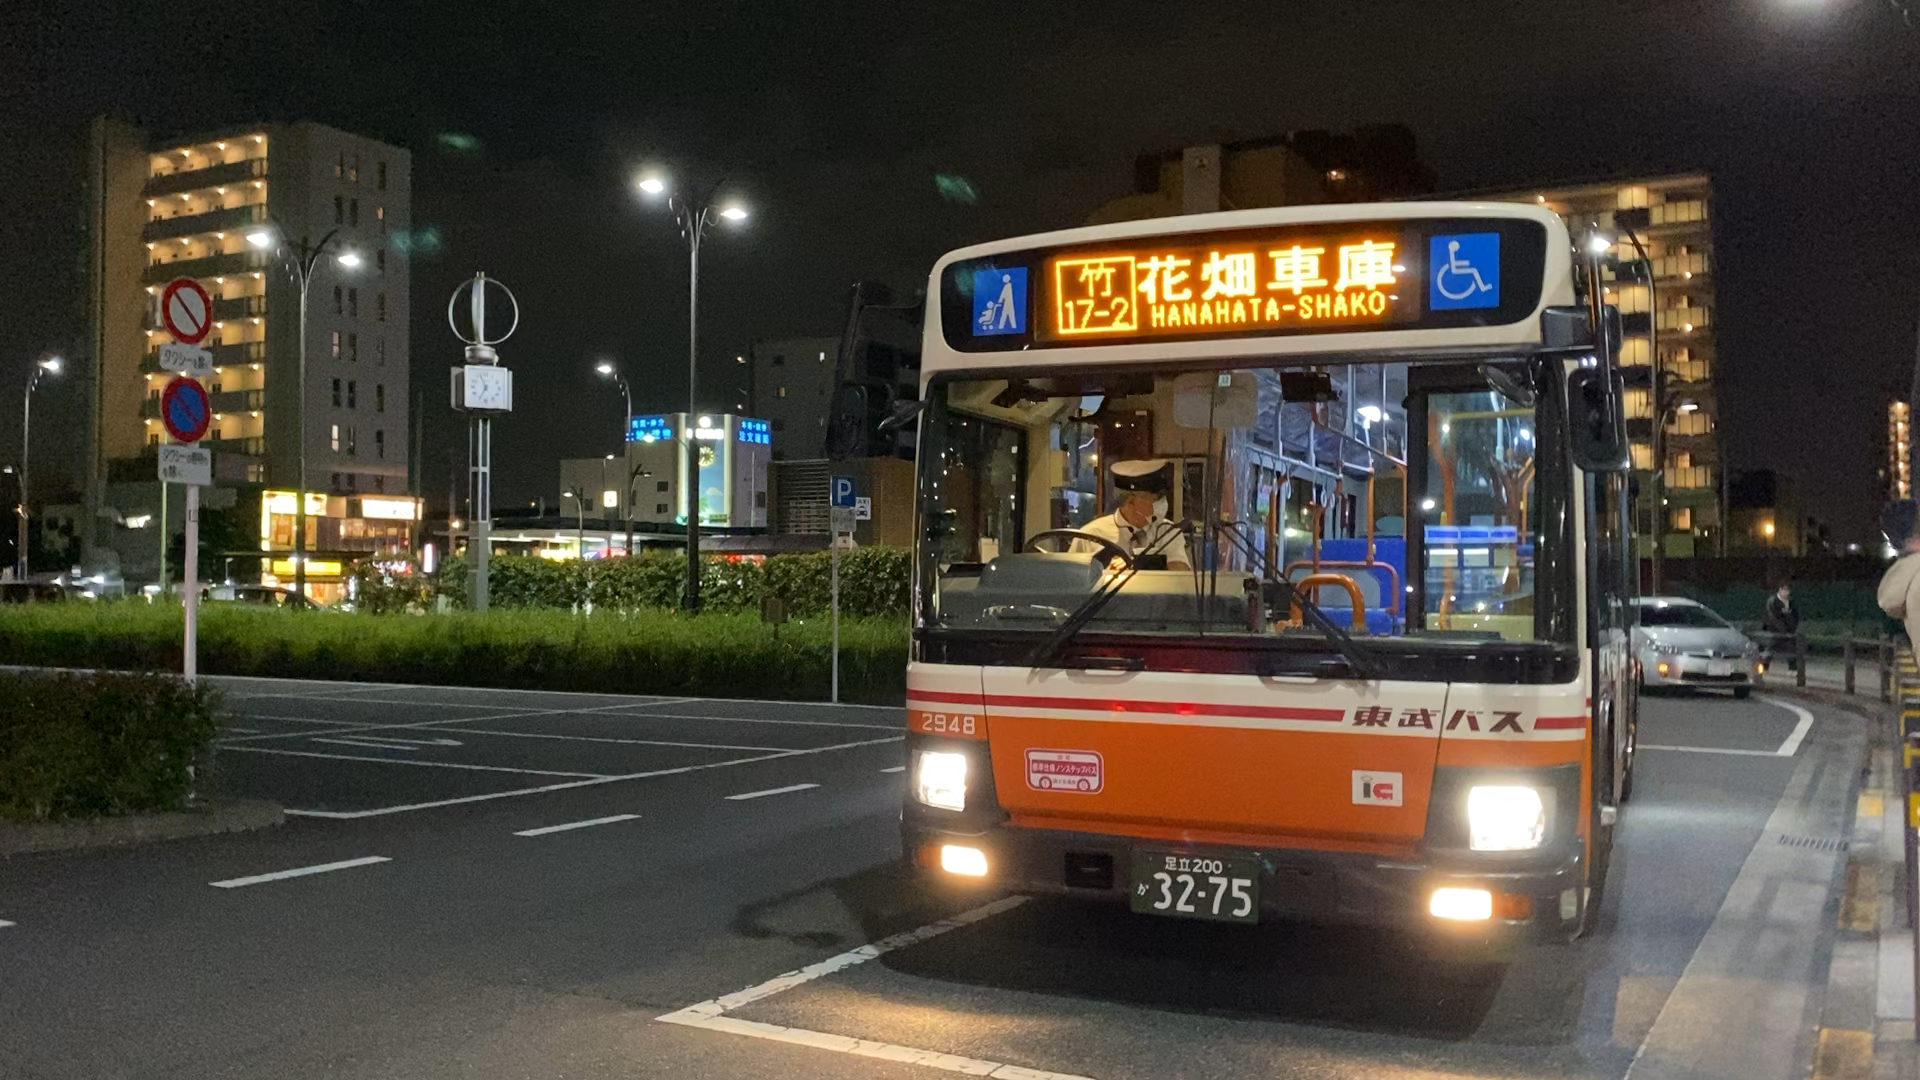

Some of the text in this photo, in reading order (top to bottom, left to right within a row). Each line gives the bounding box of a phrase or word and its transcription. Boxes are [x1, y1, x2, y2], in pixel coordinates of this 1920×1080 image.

[1079, 262, 1116, 297] 竹
[1137, 240, 1396, 304] 花畑車庫
[1064, 297, 1130, 330] 17-2
[1152, 291, 1386, 328] HANAHATA-SHAKO
[837, 479, 852, 505] P
[922, 713, 975, 735] 2948
[1352, 705, 1524, 733] 東武バス
[1165, 856, 1223, 874] 足立200
[1137, 872, 1252, 917] か 32-75
